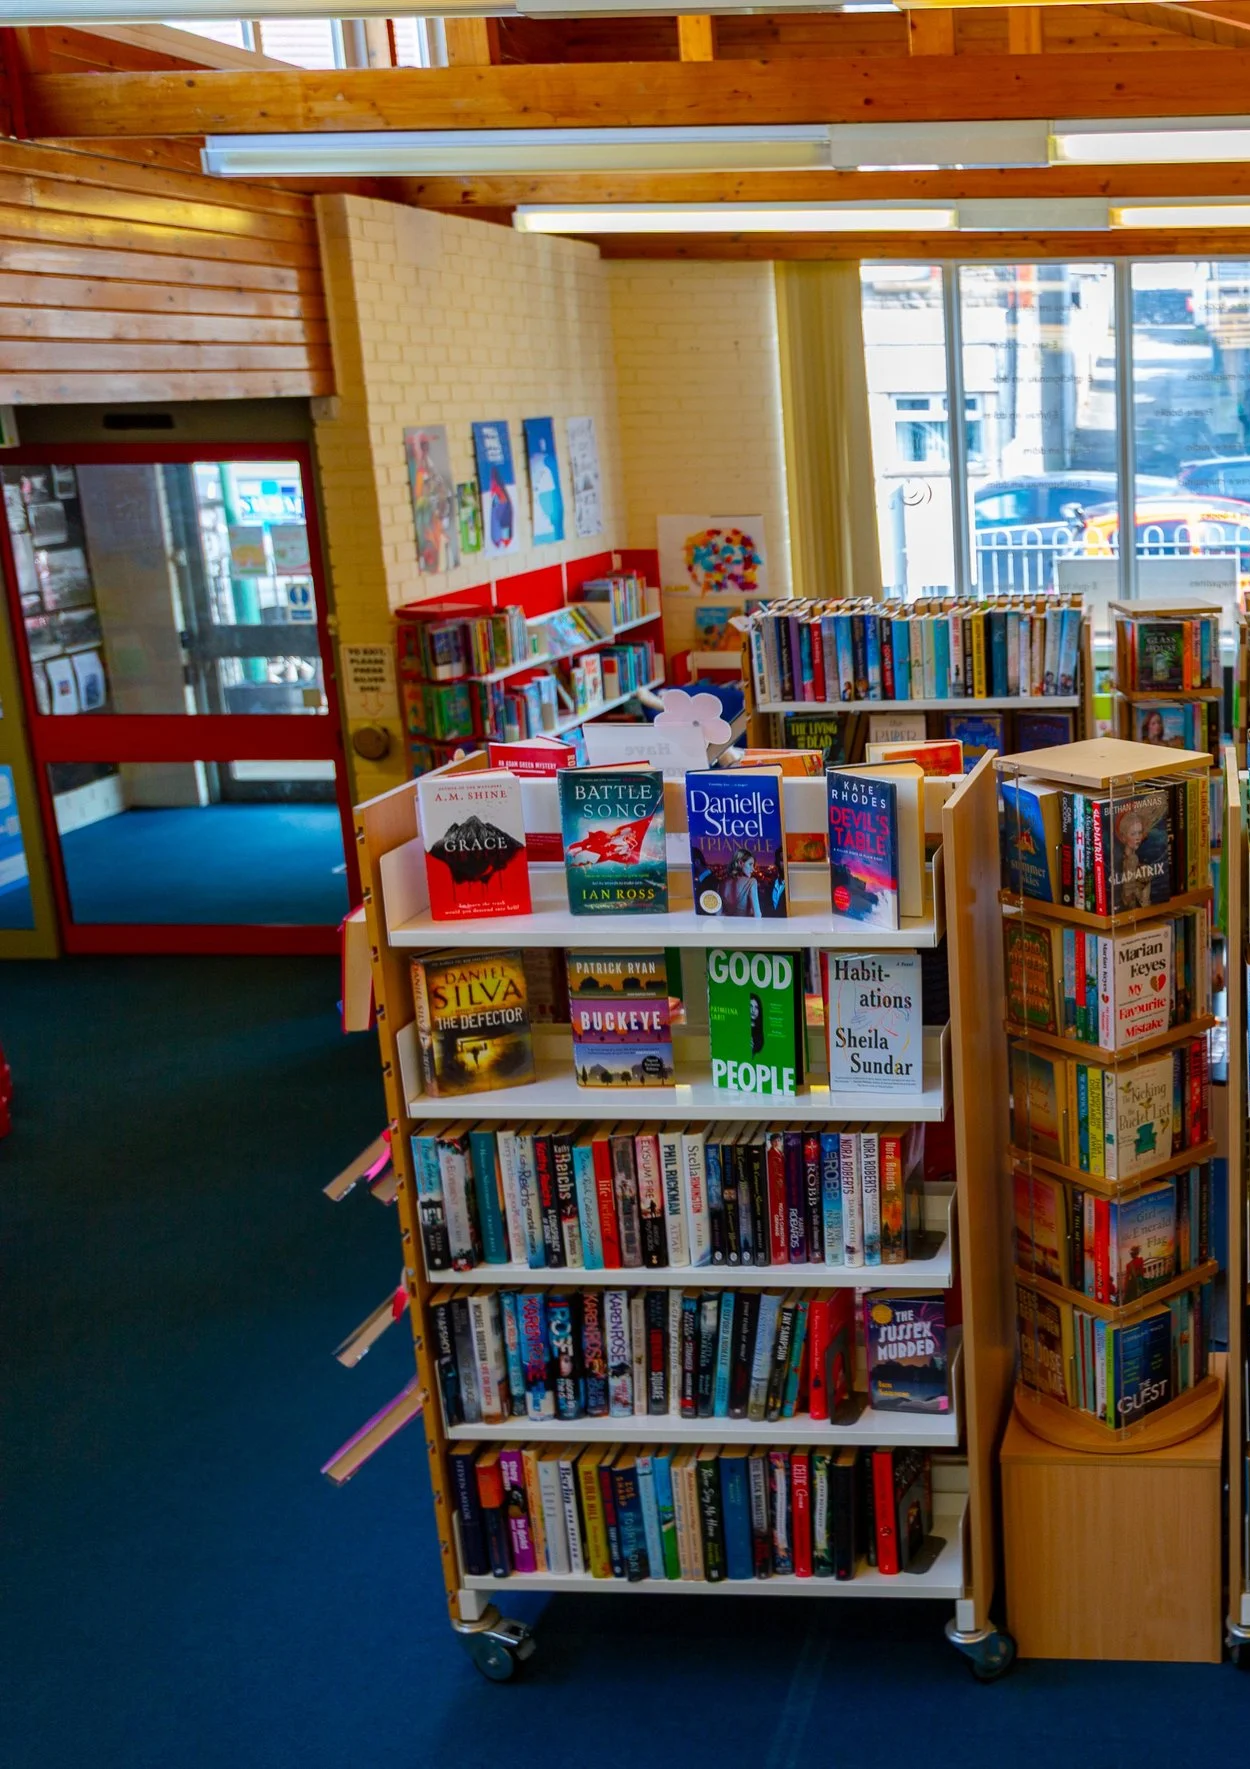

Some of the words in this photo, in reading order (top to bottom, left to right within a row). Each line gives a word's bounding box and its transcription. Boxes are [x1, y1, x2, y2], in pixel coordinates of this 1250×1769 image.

[808, 721, 838, 736] LIVING
[807, 735, 833, 749] DEAD
[468, 789, 508, 801] SHINE
[575, 785, 653, 801] BATTLE
[831, 789, 887, 809] RHODES
[843, 781, 874, 795] KATE
[583, 803, 648, 819] SONG
[690, 790, 775, 816] Danielle
[705, 808, 764, 837] Steel
[830, 806, 889, 835] DEVIL'S
[444, 837, 508, 852] GRACE
[699, 837, 773, 852] TRIANGLE
[834, 827, 886, 856] TABLE
[1092, 808, 1103, 863] GLADIATRIX
[582, 889, 611, 900] IAN
[616, 888, 656, 900] ROSS
[1118, 941, 1164, 965] Marian
[444, 965, 508, 985] DANIEL
[576, 961, 622, 974] PATRICK
[627, 961, 657, 975] RYAN
[708, 949, 793, 990] GOOD
[834, 959, 891, 982] Habit-
[1130, 958, 1167, 979] Keyes
[433, 978, 523, 1011] SILVA
[859, 988, 912, 1009] ations
[1128, 982, 1144, 997] My
[437, 1014, 459, 1031] THE
[460, 1007, 523, 1031] DEFECTOR
[1119, 997, 1167, 1020] Favourite
[580, 1010, 662, 1031] BUCKEYE
[1125, 1018, 1164, 1037] Mistake
[835, 1027, 889, 1050] Sheila
[850, 1052, 914, 1076] Sundar
[711, 1058, 796, 1097] PEOPLE
[663, 1143, 677, 1167] PHIL
[863, 1138, 876, 1159] NORA
[555, 1153, 574, 1200] Reichs
[864, 1160, 878, 1194] ROBERTS
[667, 1169, 681, 1216] RICKMAN
[609, 1293, 624, 1330] KAREN
[895, 1310, 915, 1322] THE
[877, 1321, 933, 1343] SUSSEX
[611, 1330, 626, 1363] ROSE
[1117, 1379, 1168, 1414] GUEST
[560, 1467, 575, 1505] Berlin
